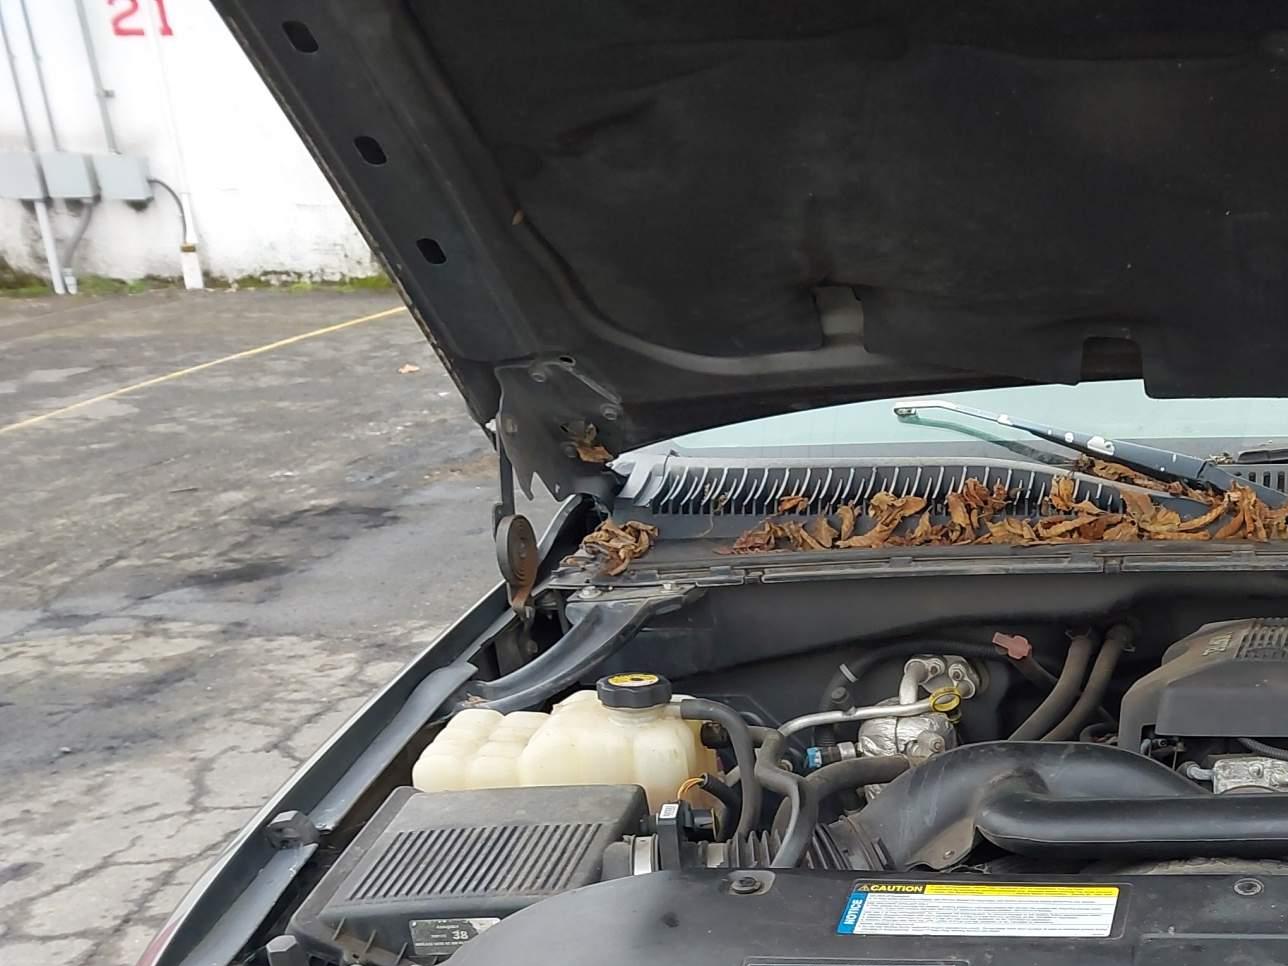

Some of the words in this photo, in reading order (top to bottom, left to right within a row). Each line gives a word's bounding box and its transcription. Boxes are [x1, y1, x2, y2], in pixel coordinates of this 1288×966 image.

[870, 885, 924, 893] CAUTION
[843, 899, 863, 925] NOTICE
[451, 930, 469, 940] 38
